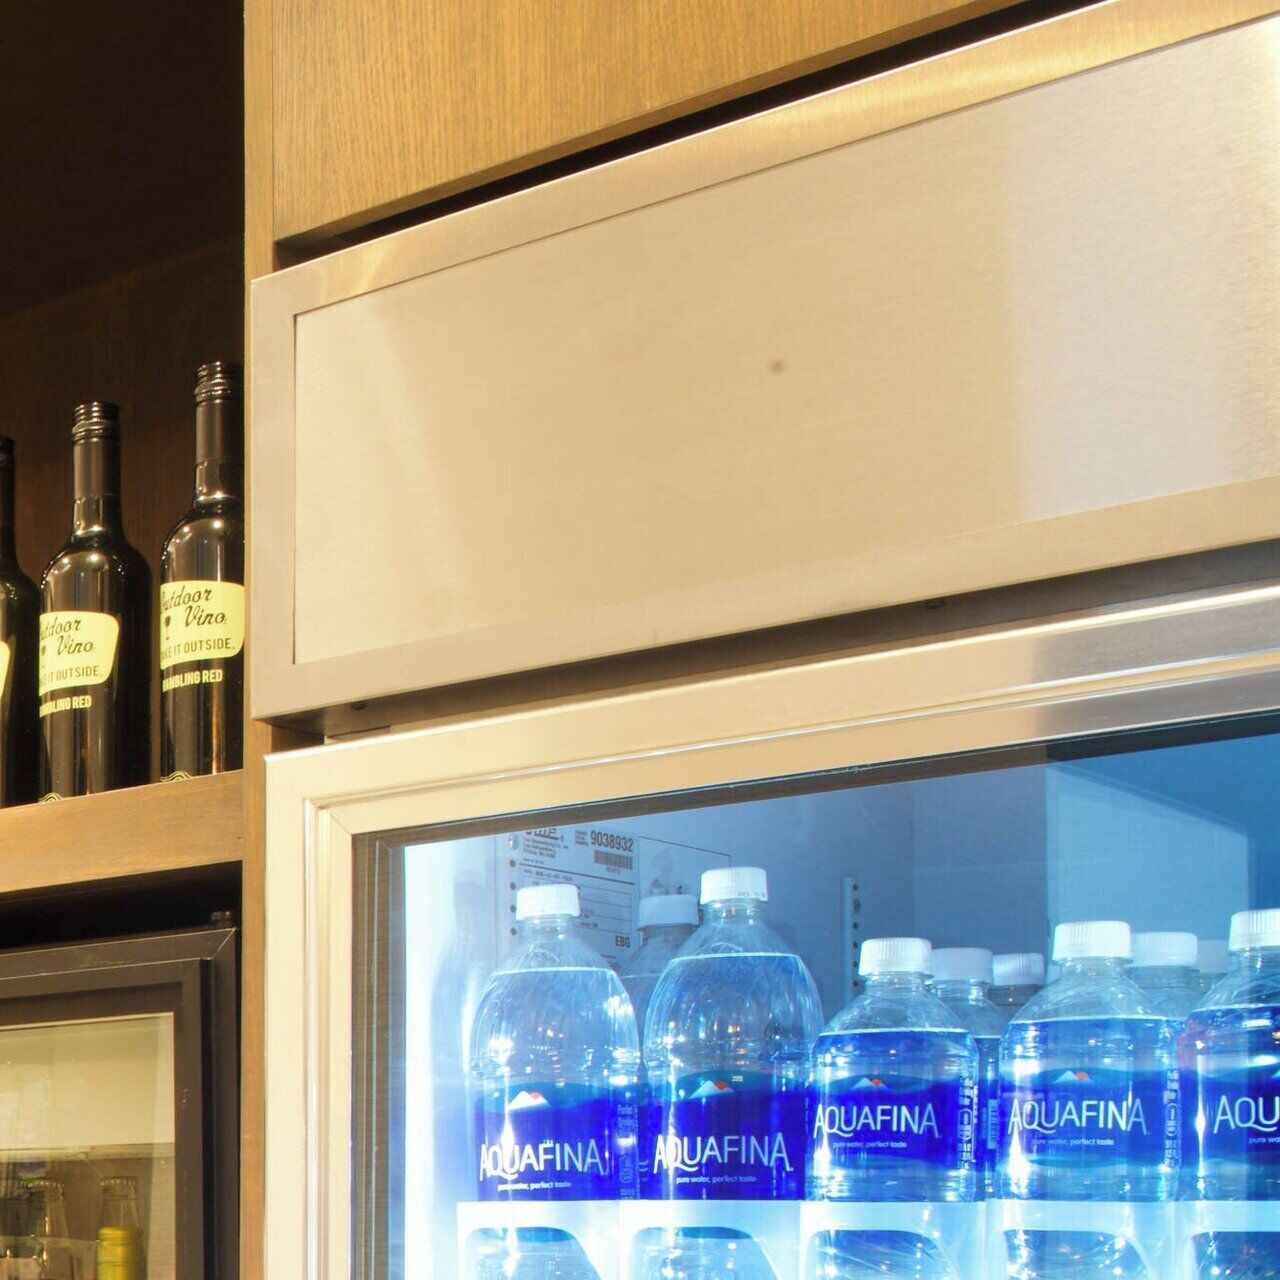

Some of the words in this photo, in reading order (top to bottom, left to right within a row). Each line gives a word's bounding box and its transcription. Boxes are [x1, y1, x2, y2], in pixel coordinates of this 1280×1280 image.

[185, 604, 226, 627] Vino
[57, 635, 94, 656] Vino
[202, 669, 223, 684] RED
[73, 695, 92, 709] RED
[590, 831, 633, 852] 9038932
[813, 1102, 939, 1138] AQUAFINA
[1008, 1097, 1148, 1136] AQUAFINA
[653, 1131, 790, 1174] AQUAFINA
[869, 1140, 890, 1149] perfect
[1070, 1137, 1095, 1147] perfect
[1096, 1137, 1115, 1145] taste
[479, 1139, 604, 1181] AQUAFINA
[712, 1175, 738, 1184] perfect
[739, 1174, 757, 1183] taste
